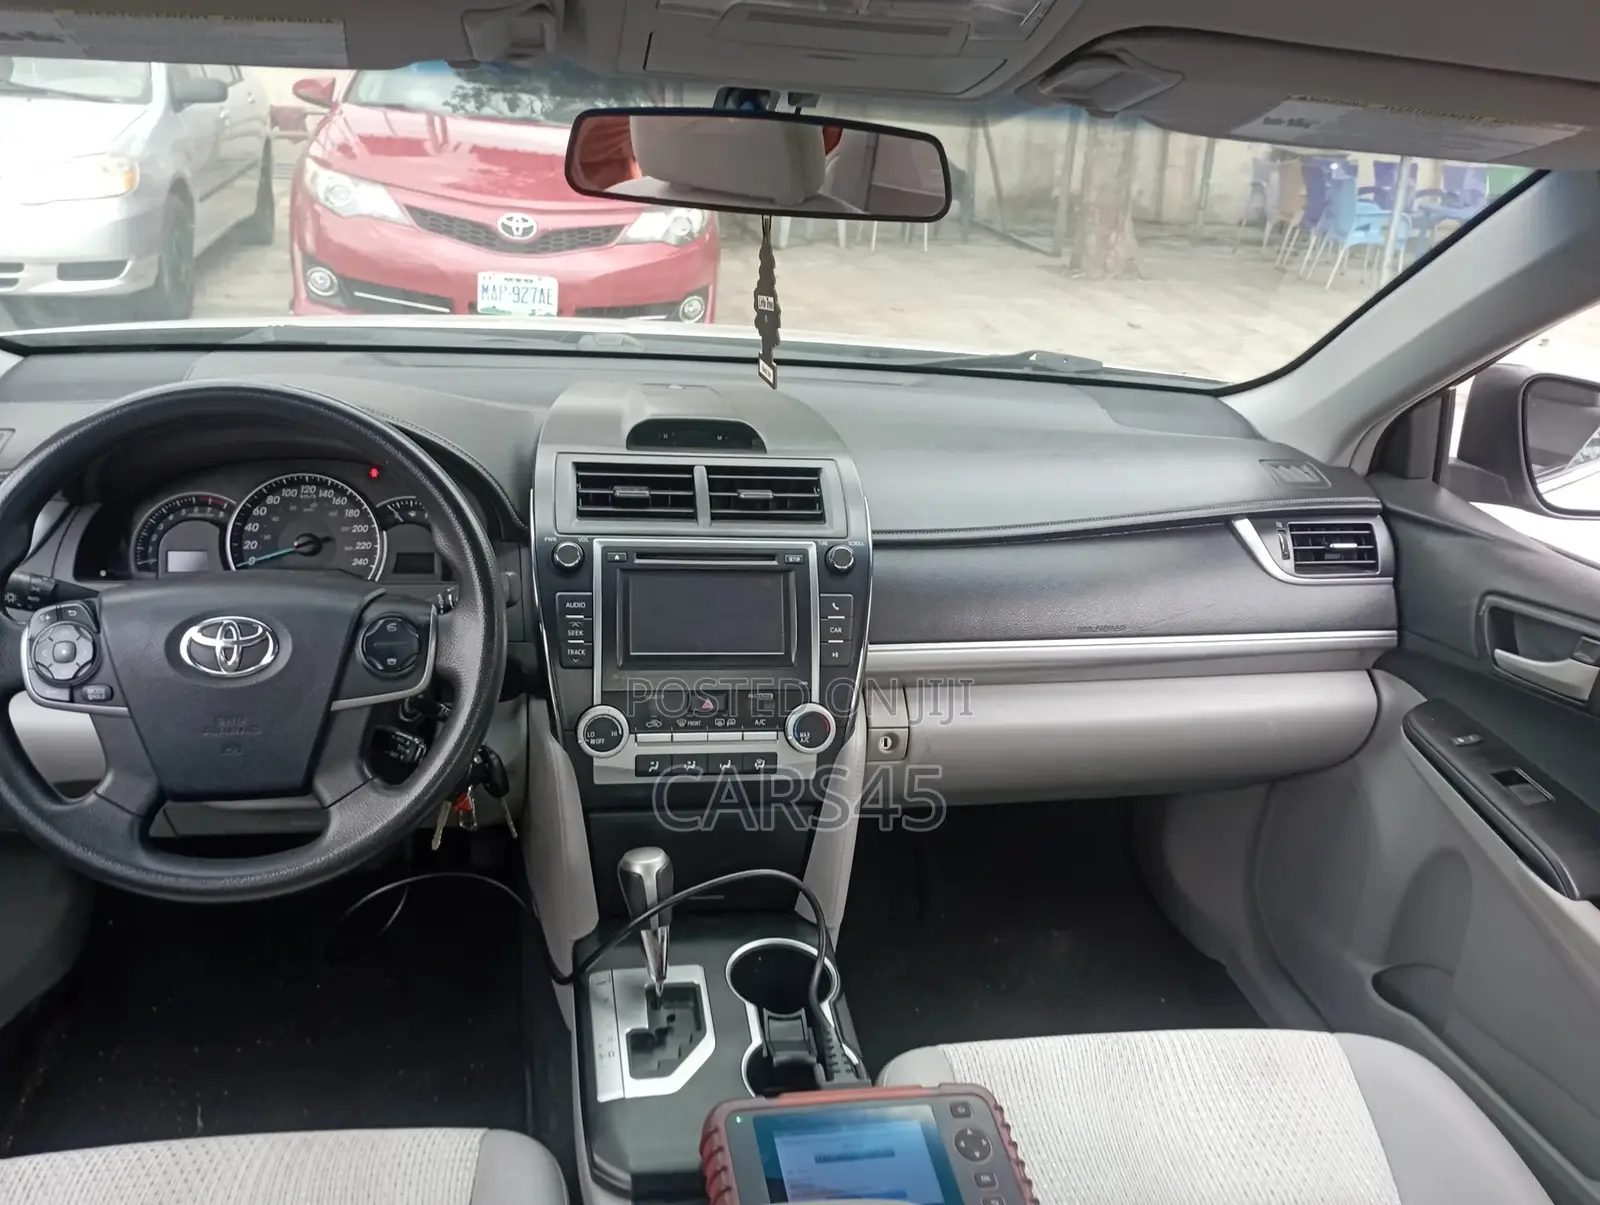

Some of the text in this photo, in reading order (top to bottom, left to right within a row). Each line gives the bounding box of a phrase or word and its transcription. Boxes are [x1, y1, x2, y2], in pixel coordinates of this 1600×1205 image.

[281, 488, 298, 497] 100
[301, 485, 316, 493] 120
[319, 489, 334, 498] 140
[266, 495, 280, 504] 80
[332, 497, 347, 505] 160
[252, 507, 267, 516] 60
[344, 508, 360, 518] 180
[244, 523, 259, 532] 40
[351, 525, 368, 533] 200
[243, 541, 258, 549] 20
[355, 541, 372, 550] 220
[351, 558, 368, 566] 240
